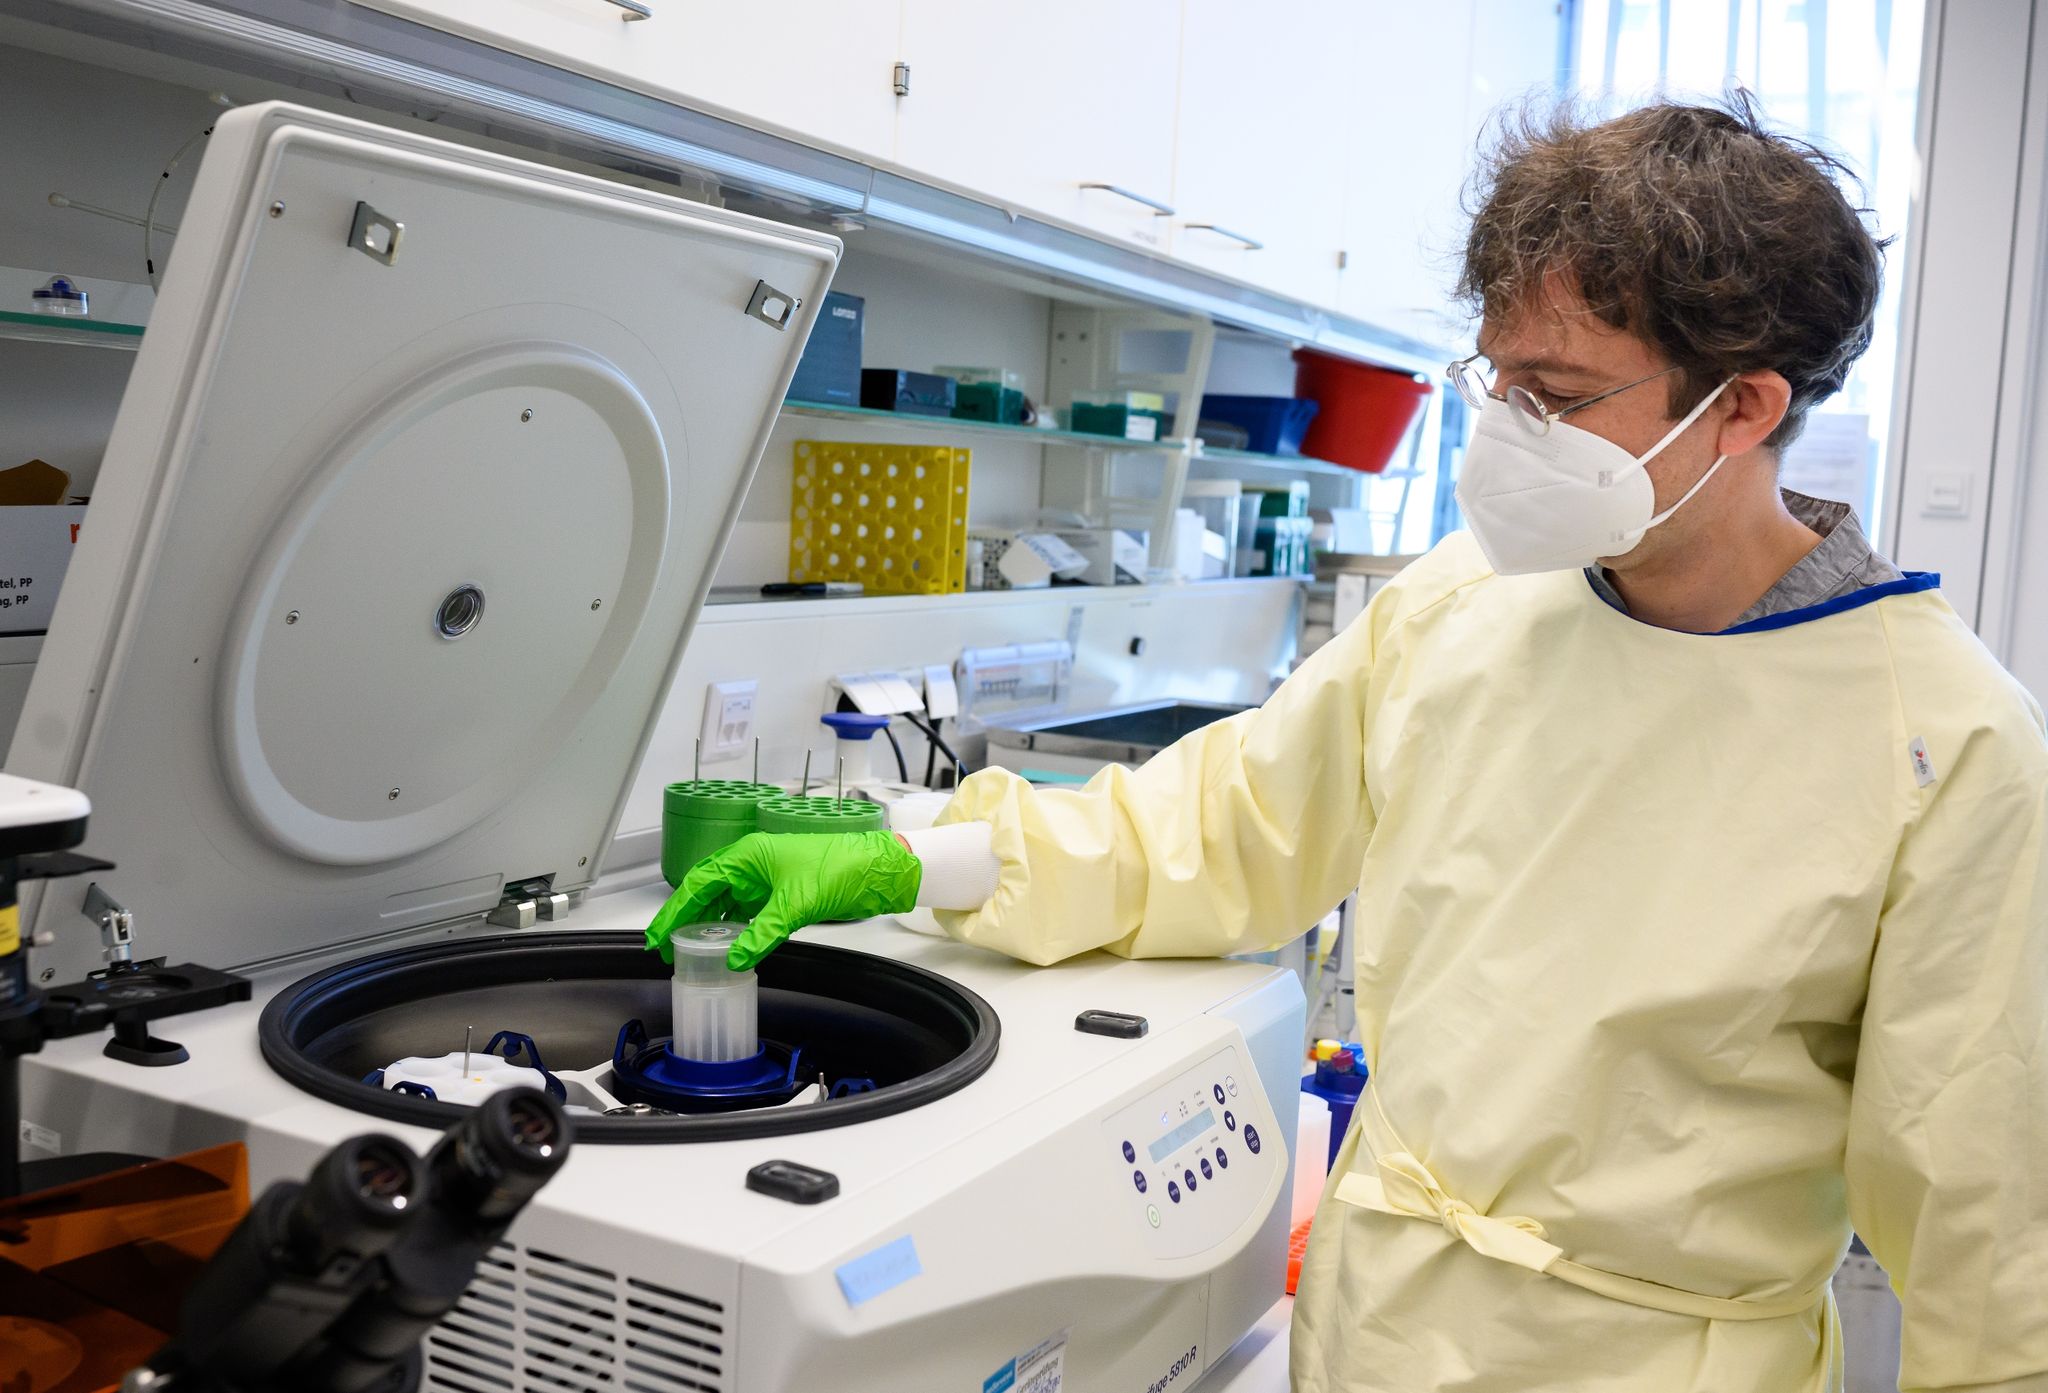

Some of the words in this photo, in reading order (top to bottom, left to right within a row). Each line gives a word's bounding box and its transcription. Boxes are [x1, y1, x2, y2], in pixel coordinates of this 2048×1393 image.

[19, 577, 33, 588] PP
[15, 594, 29, 605] PP
[1169, 1352, 1190, 1382] 5810
[1189, 1345, 1197, 1364] R
